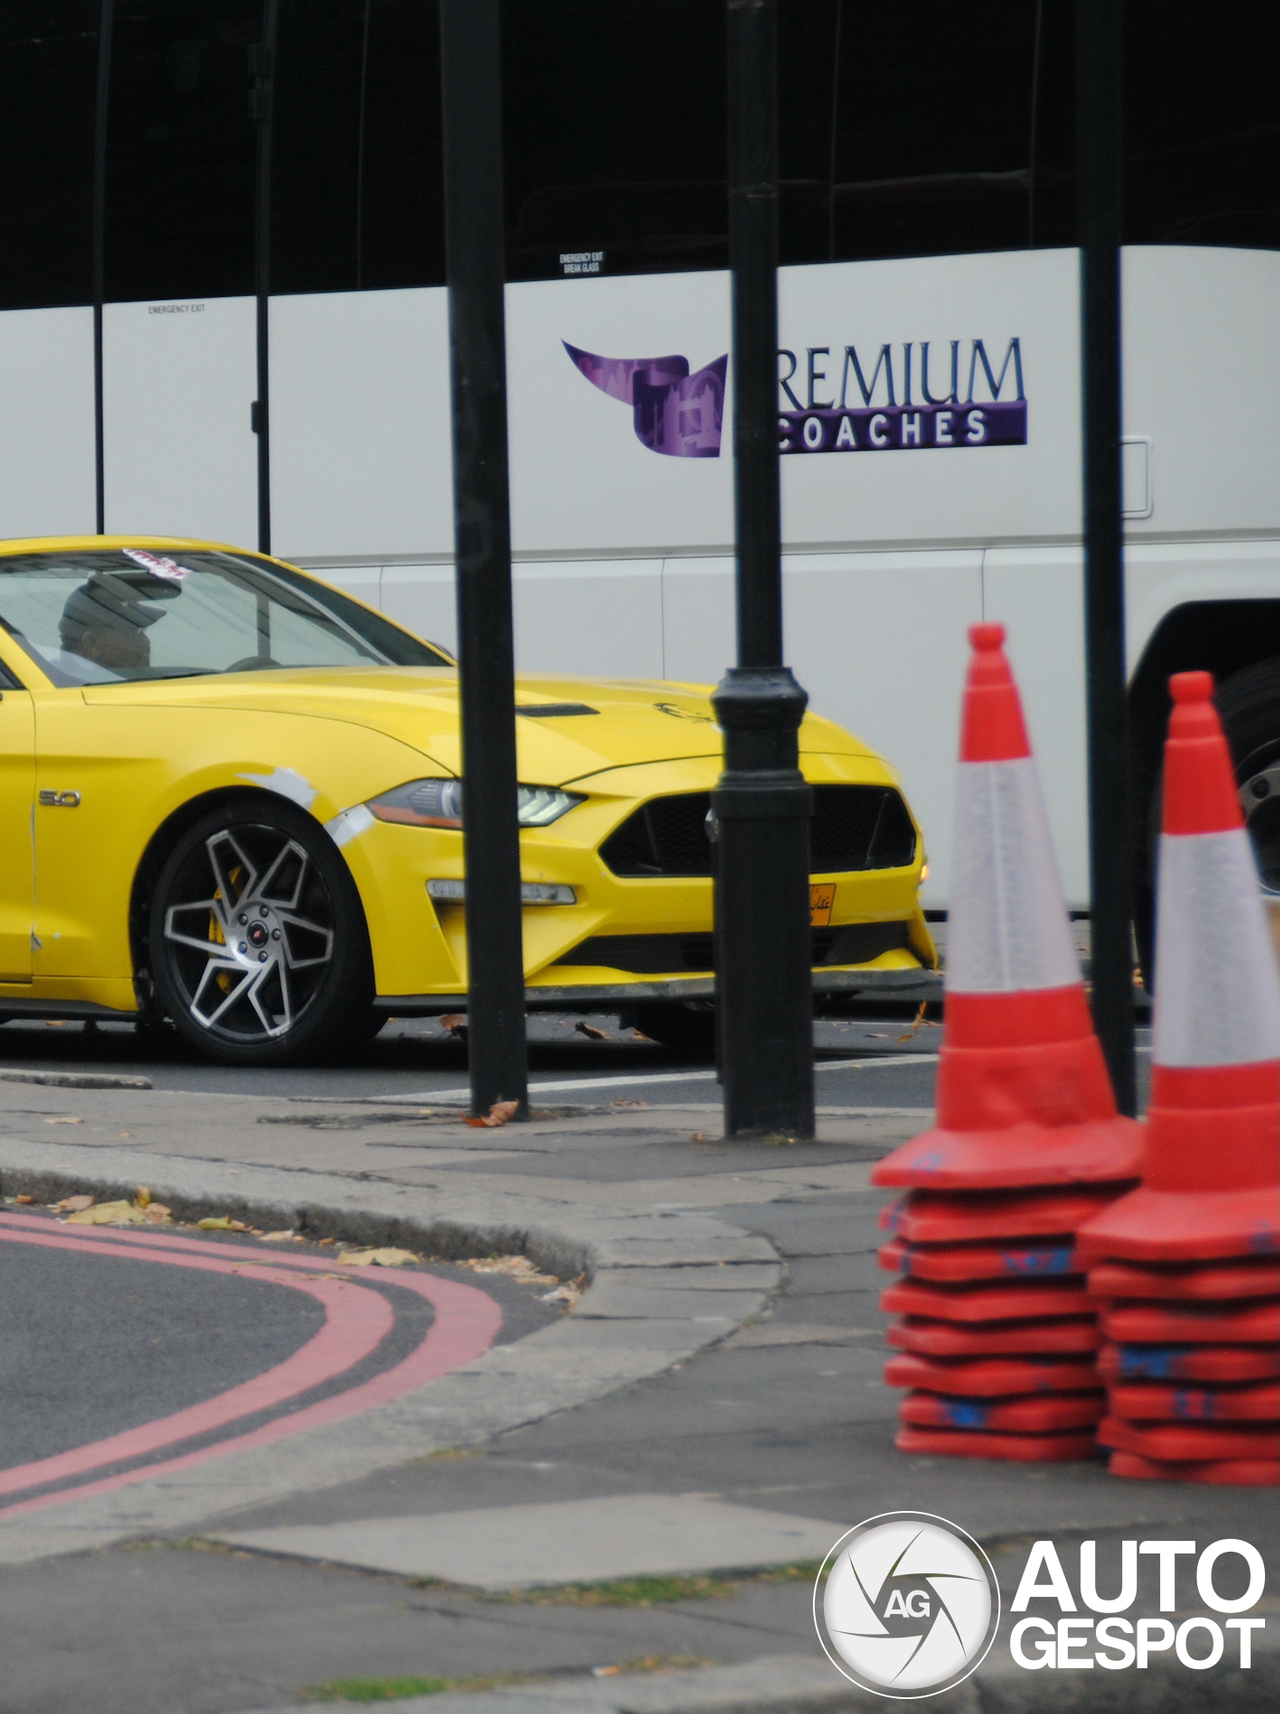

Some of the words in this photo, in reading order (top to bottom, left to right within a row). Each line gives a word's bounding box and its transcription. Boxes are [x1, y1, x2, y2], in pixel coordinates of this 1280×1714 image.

[560, 252, 590, 263] EMERGENCY
[591, 251, 603, 262] EXIT
[581, 262, 600, 272] GLASS
[148, 304, 189, 314] EMERGENCY
[190, 303, 205, 312] EXIT
[777, 337, 1027, 411] REMIUM
